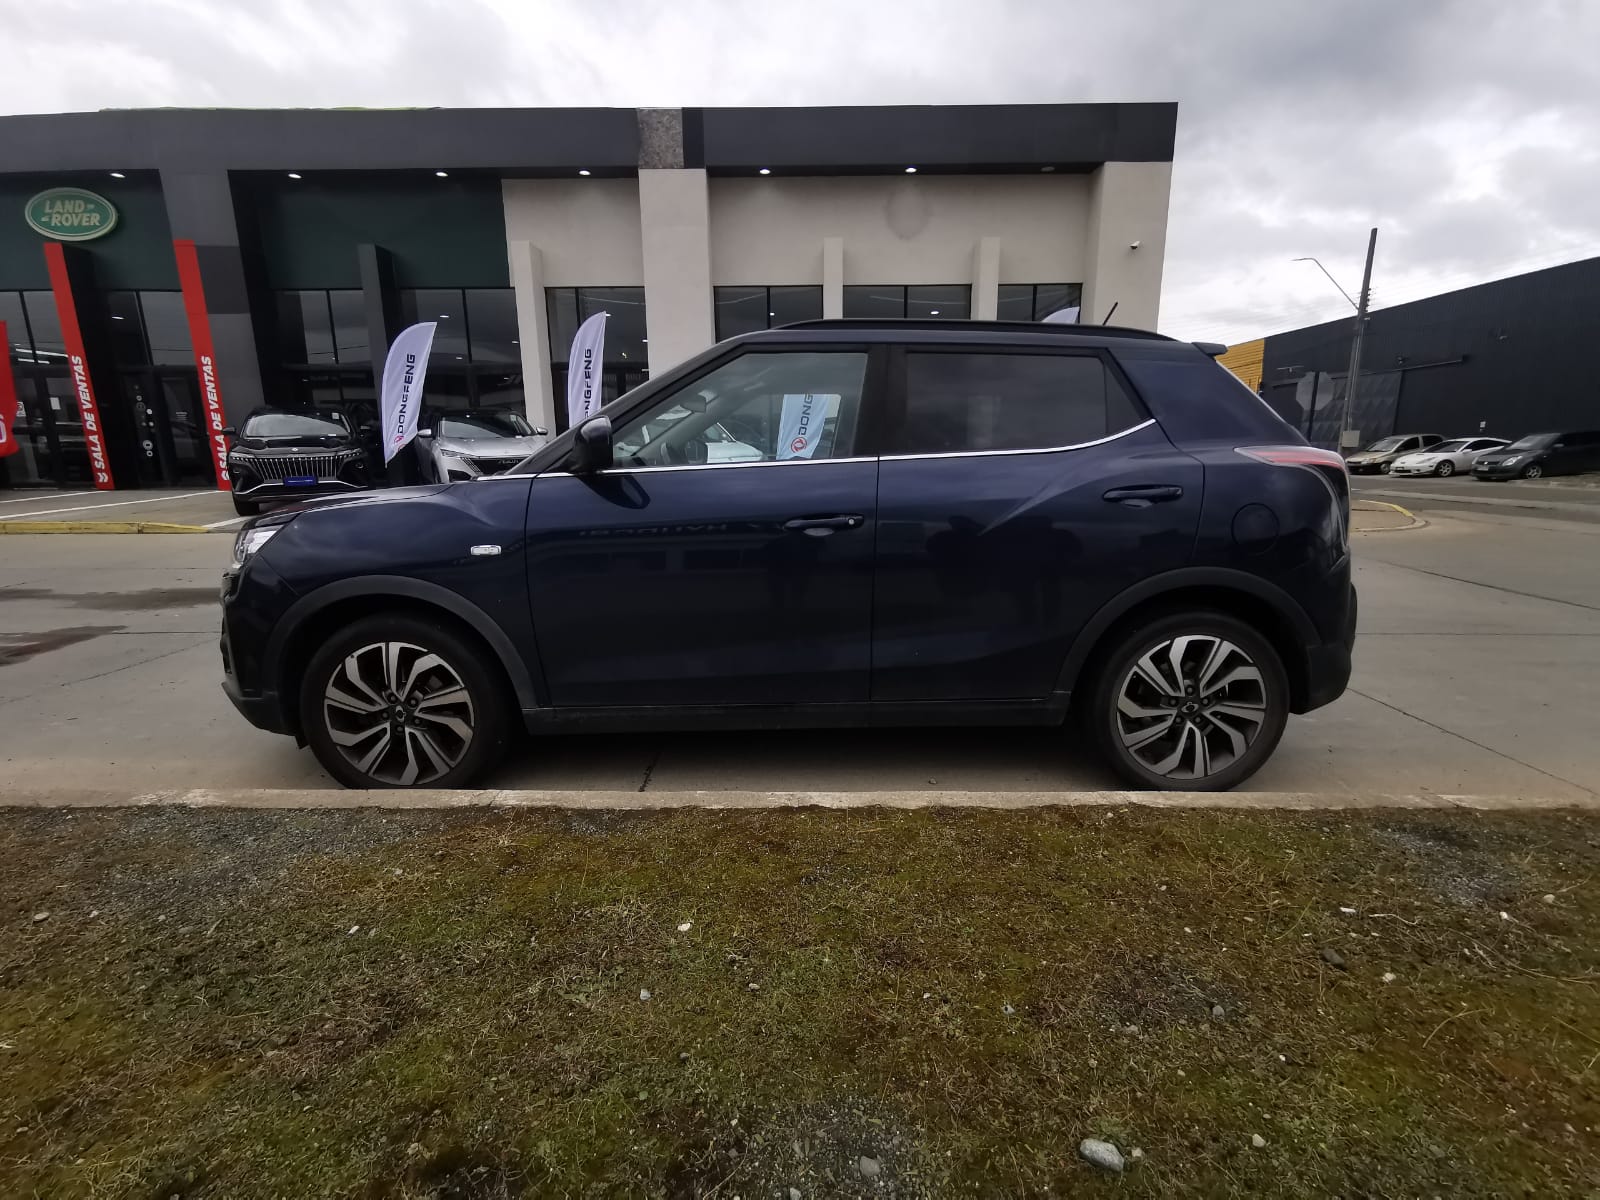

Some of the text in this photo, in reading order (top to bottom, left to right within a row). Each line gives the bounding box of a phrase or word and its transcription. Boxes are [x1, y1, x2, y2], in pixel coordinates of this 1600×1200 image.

[44, 200, 85, 213] LAND
[51, 213, 101, 226] ROVER
[71, 355, 105, 470] SALA DE VENTAS
[201, 355, 228, 470] SALA DE VENTAS
[397, 353, 416, 434] DONGFENG
